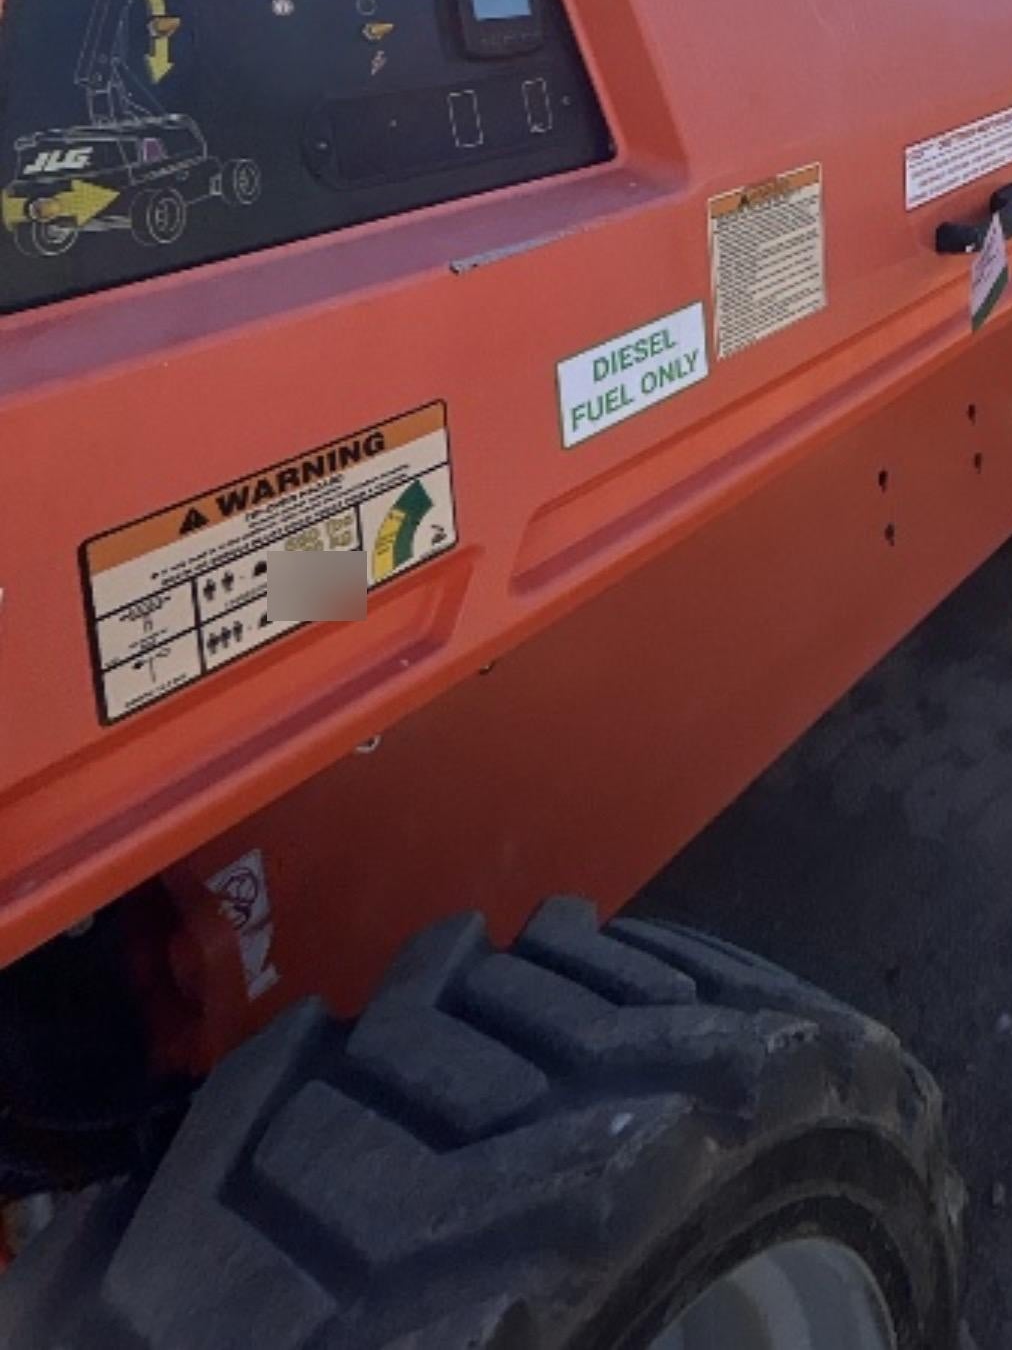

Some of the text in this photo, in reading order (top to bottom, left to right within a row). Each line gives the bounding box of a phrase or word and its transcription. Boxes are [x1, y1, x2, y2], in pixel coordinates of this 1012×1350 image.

[23, 147, 94, 175] JLG
[592, 329, 677, 383] DIESEL
[571, 349, 699, 432] FUEL ONLY
[217, 431, 386, 517] WARNING
